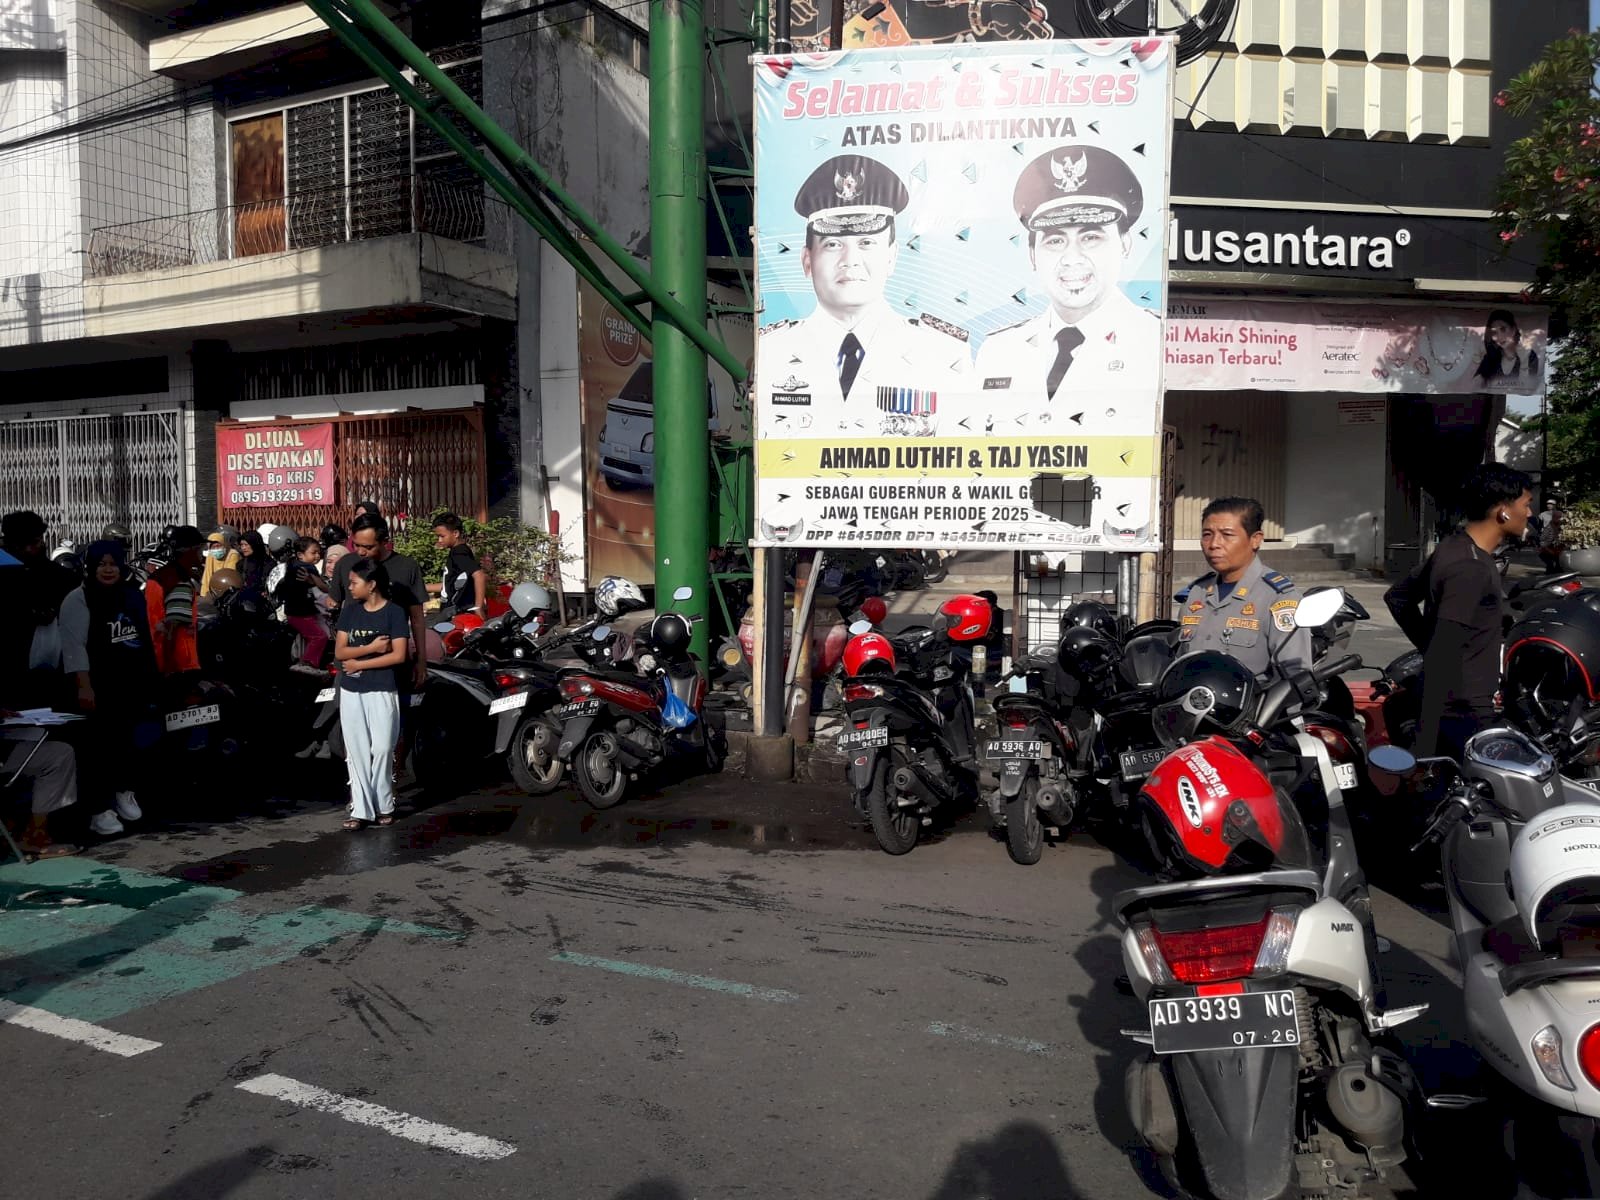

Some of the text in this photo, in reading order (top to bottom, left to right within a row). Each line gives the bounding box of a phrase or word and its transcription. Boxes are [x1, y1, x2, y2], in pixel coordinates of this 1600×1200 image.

[783, 68, 1138, 118] Selamat & Sukses
[841, 117, 1077, 147] ATAS DILANTIKNYA
[605, 317, 637, 334] GRAND
[609, 331, 634, 346] PRIZE
[1184, 327, 1233, 344] Makin
[1239, 327, 1298, 351] Shining
[1219, 348, 1282, 366] Terbaru!
[1321, 351, 1360, 362] Aeratec
[773, 395, 791, 404] AHMAD
[245, 430, 304, 450] DIJUAL
[227, 449, 325, 471] DISEWAKAN
[820, 445, 1089, 469] AHMAD LUTHFI & TAJ YASIN
[236, 470, 315, 487] Hub. Bp KRIS
[231, 488, 323, 503] 089519329119
[805, 486, 864, 500] SEBAGAI
[868, 486, 947, 500] GUBERNUR
[951, 485, 962, 500] &
[967, 485, 1014, 500] WAKIL
[820, 506, 859, 520] JAWA
[863, 506, 919, 520] TENGAH
[924, 507, 986, 521] PERIODE
[991, 507, 1029, 521] 2025
[805, 530, 833, 541] DPP
[988, 742, 999, 751] AD
[1124, 757, 1137, 768] AD
[1181, 780, 1200, 821] INK
[1154, 994, 1294, 1026] AD 3939 NC
